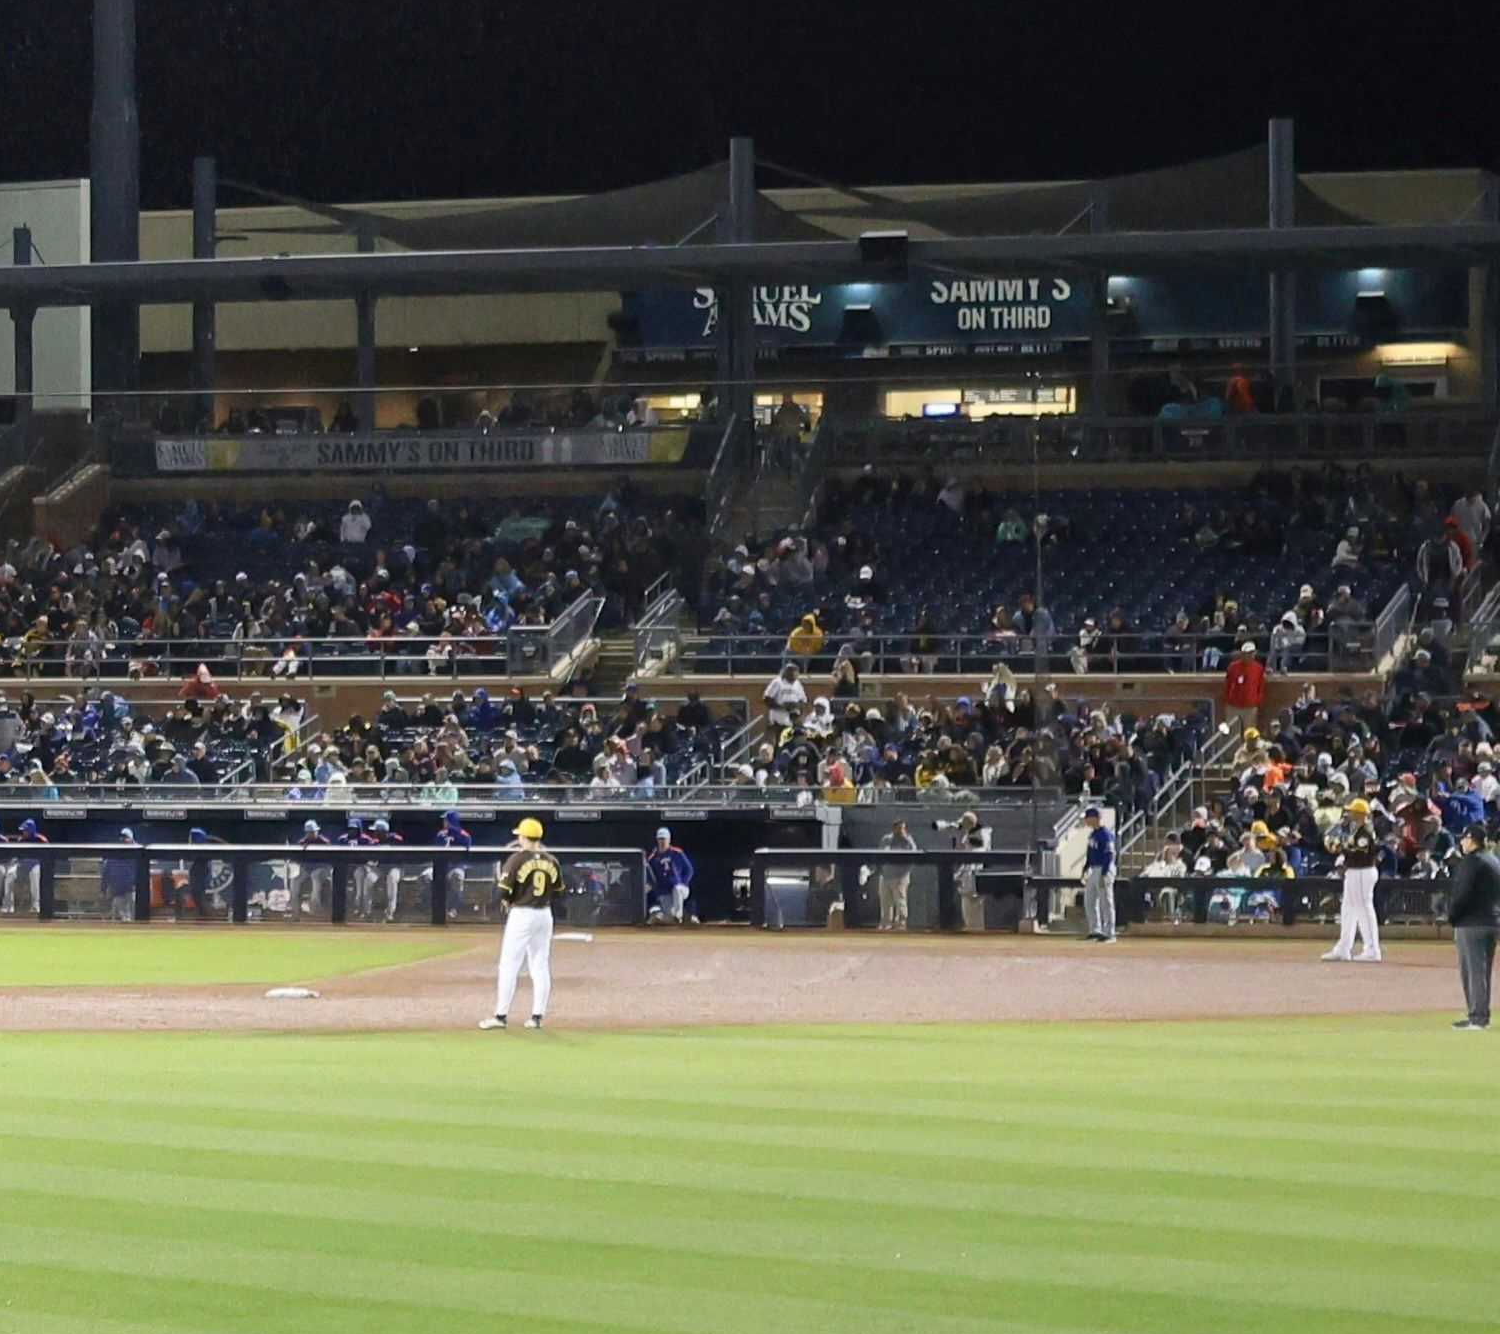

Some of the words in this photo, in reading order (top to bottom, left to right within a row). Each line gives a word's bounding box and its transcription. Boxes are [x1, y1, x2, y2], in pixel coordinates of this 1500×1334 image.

[693, 285, 822, 309] SUEL
[930, 278, 1071, 304] SAMMYS
[958, 307, 985, 330] ON
[990, 306, 1051, 330] THIRD
[318, 442, 421, 464] SAMMY'S
[429, 441, 459, 460] ON
[468, 440, 534, 462] THIRD
[533, 871, 546, 897] 9
